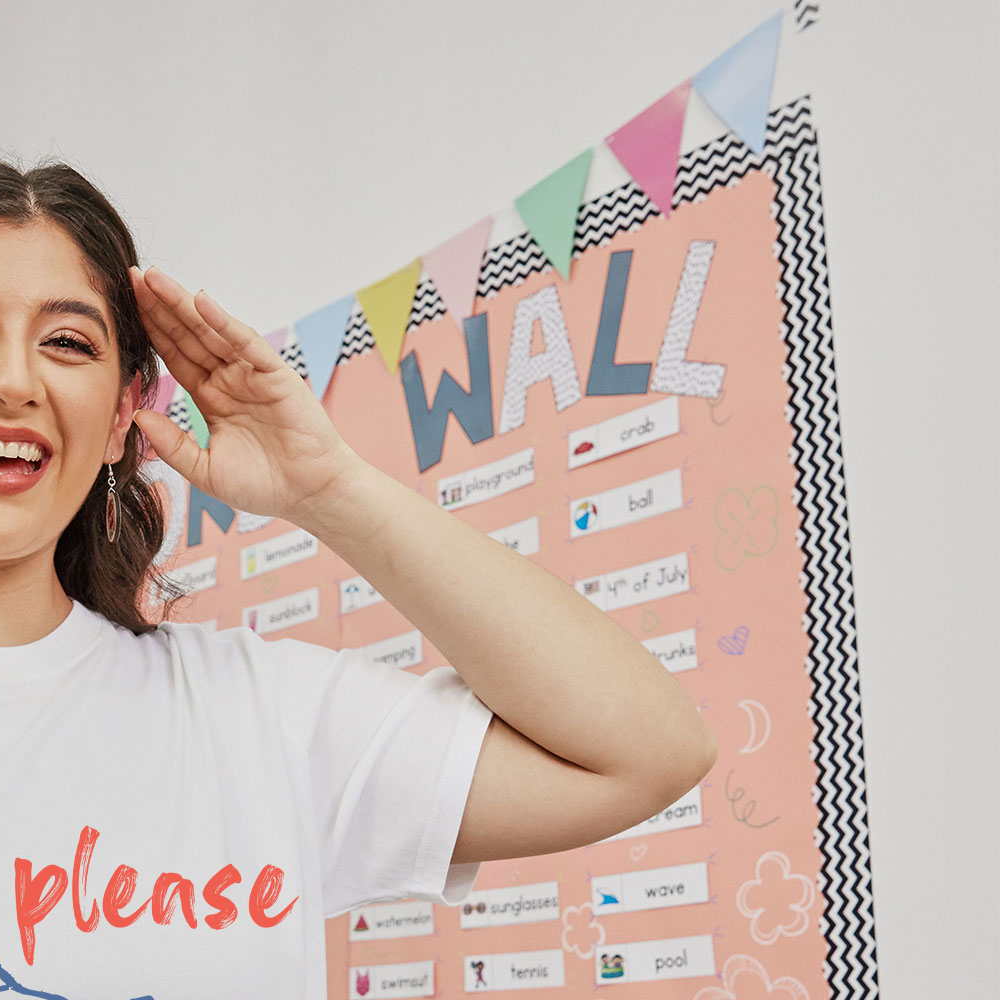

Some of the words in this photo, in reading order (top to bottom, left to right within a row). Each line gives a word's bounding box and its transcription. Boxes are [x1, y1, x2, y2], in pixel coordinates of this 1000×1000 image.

[399, 239, 728, 475] WALL
[620, 416, 655, 442] crab
[465, 455, 534, 497] playground
[628, 488, 654, 512] ball
[264, 538, 314, 562] lemonade
[633, 571, 651, 591] of
[656, 564, 688, 587] July
[269, 601, 313, 624] sunblock
[15, 825, 300, 966] please
[645, 880, 685, 899] wave
[490, 894, 559, 917] sunglasses
[375, 911, 432, 928] watermelon
[510, 966, 549, 981] tennis
[655, 948, 688, 975] pool
[381, 974, 429, 990] swimsuit
